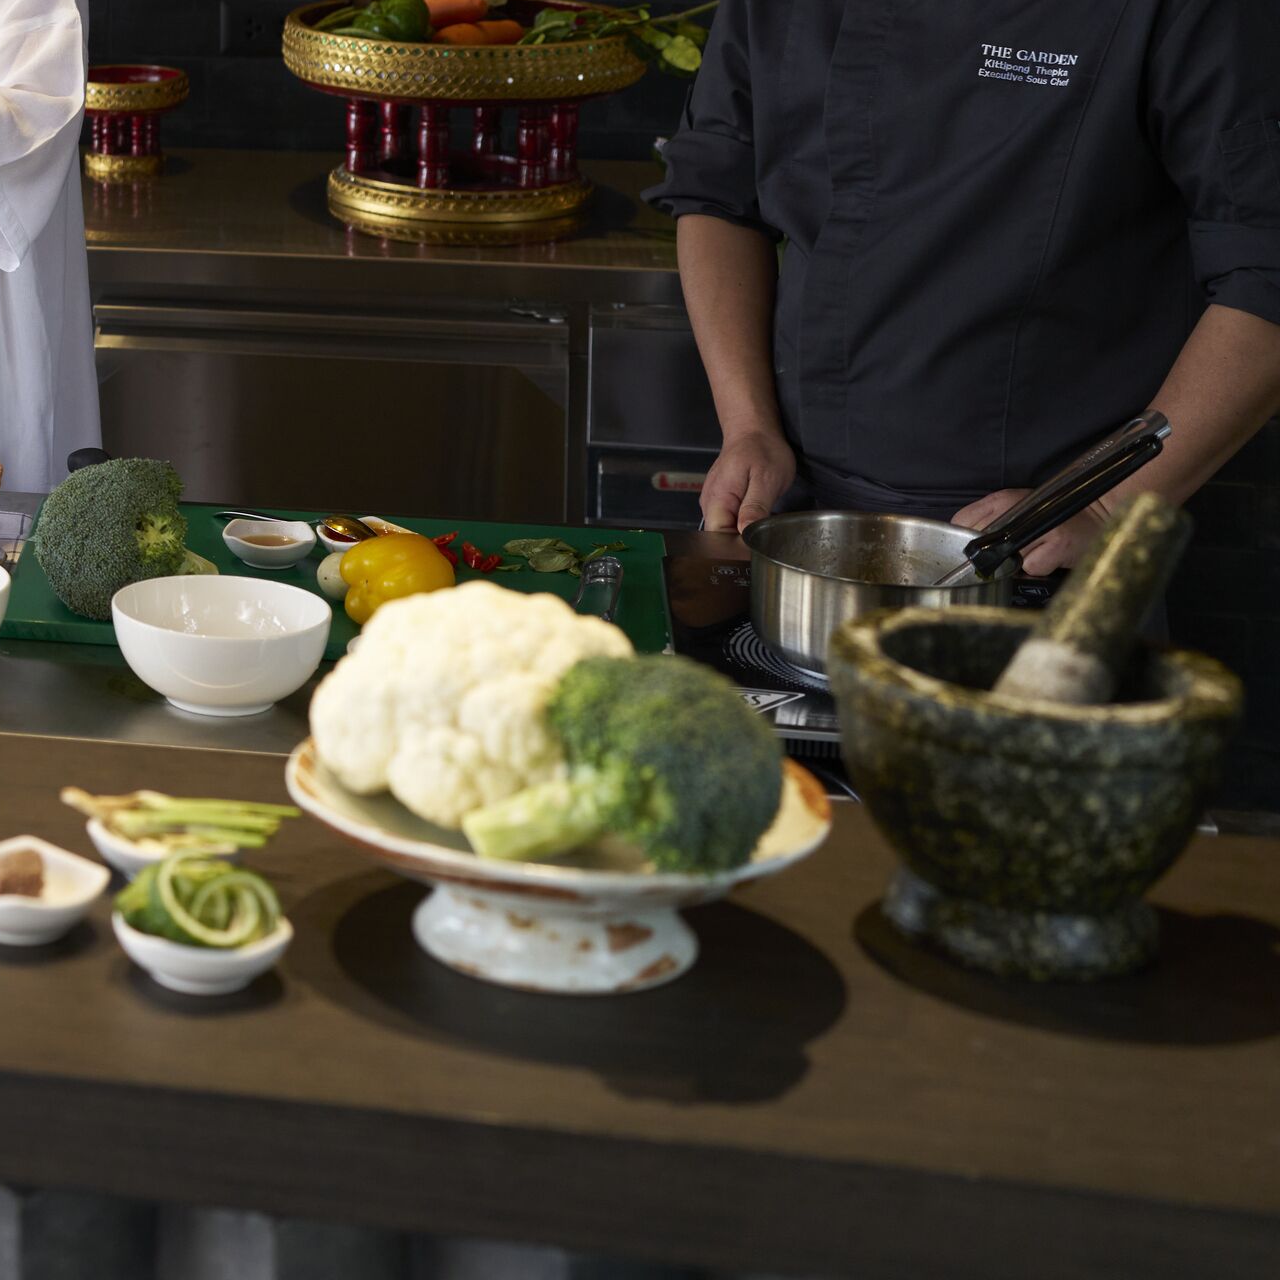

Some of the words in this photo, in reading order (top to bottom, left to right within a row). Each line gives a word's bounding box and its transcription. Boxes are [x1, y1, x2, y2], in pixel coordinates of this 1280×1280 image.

[981, 43, 1013, 59] THE
[1016, 49, 1079, 66] GARDEN
[978, 68, 1024, 82] Executive
[1025, 75, 1048, 85] Sous
[1050, 77, 1070, 87] Chef
[984, 59, 1030, 74] Kittipong
[1035, 65, 1069, 77] Thepka
